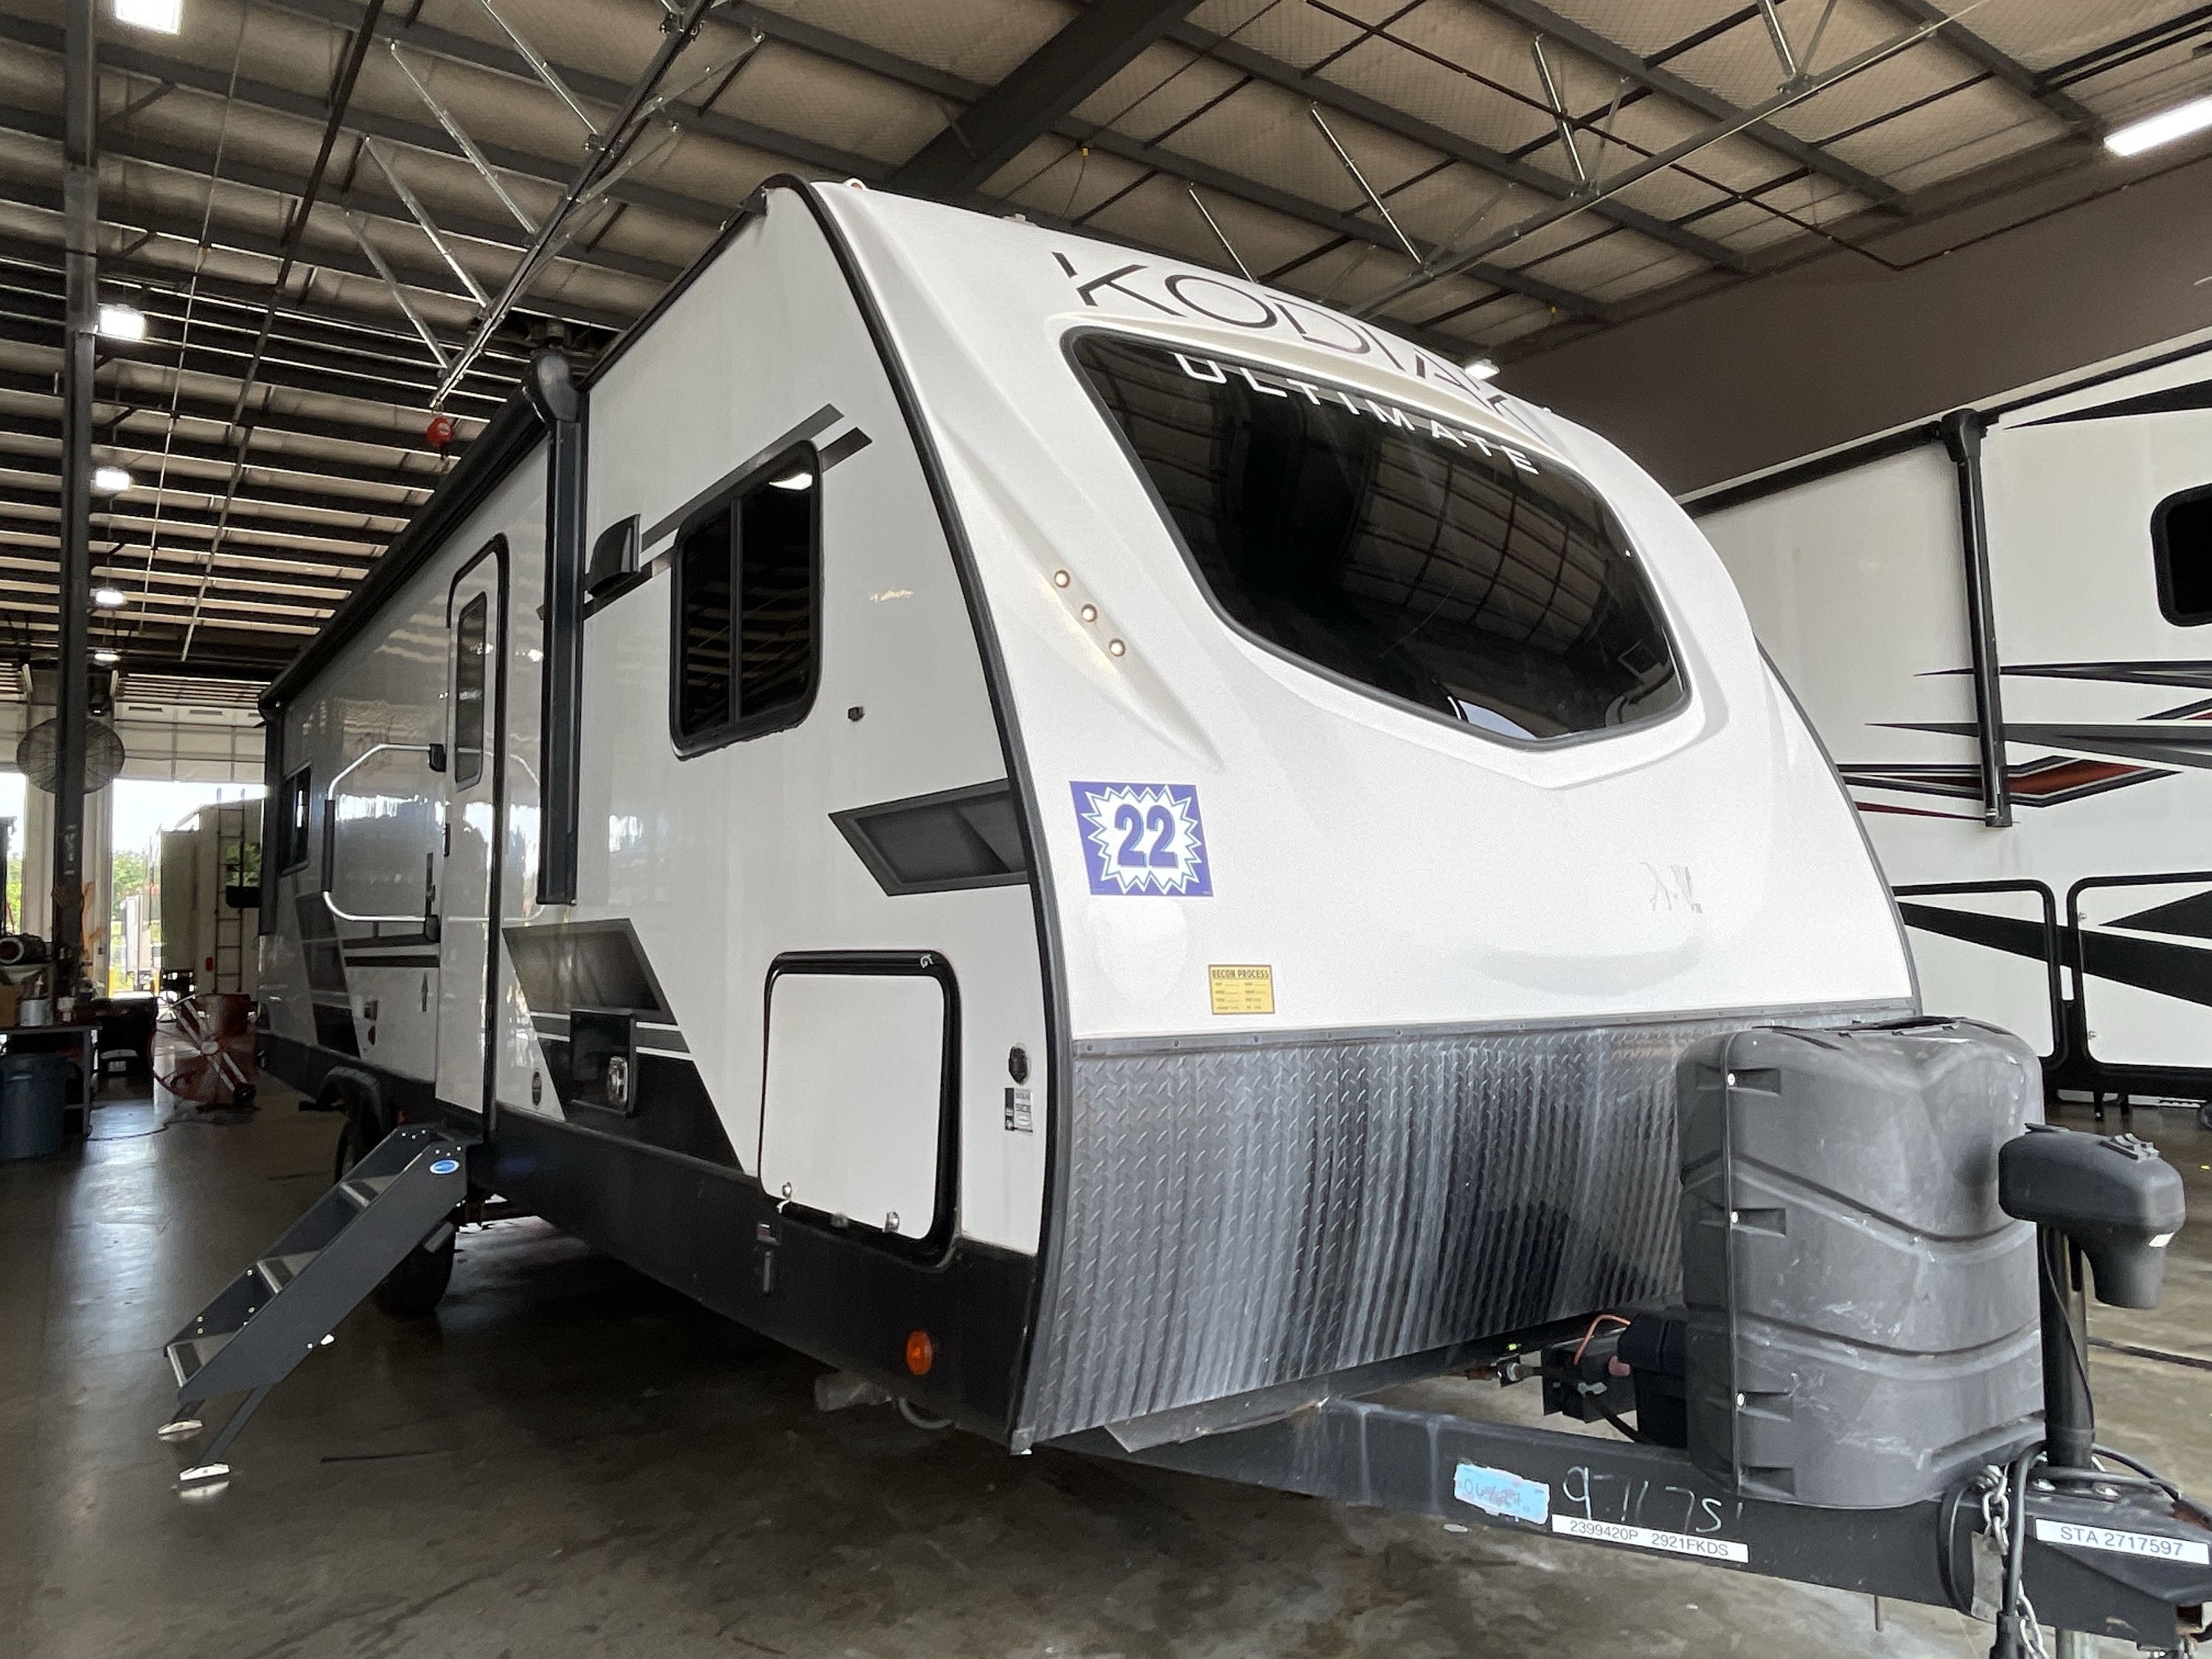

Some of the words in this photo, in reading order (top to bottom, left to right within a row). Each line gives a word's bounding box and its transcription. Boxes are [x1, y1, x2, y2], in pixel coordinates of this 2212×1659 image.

[1051, 251, 1551, 447] KODIAK
[1174, 352, 1540, 475] ULTIMATE
[1114, 803, 1179, 869] 22
[1211, 969, 1236, 980] RECON
[1237, 969, 1270, 980] PROCESS
[1570, 1520, 1639, 1541] 2399420P
[1651, 1532, 1728, 1557] 2921FKDS
[2060, 1526, 2099, 1545] STA
[2104, 1532, 2183, 1557] 2717597
